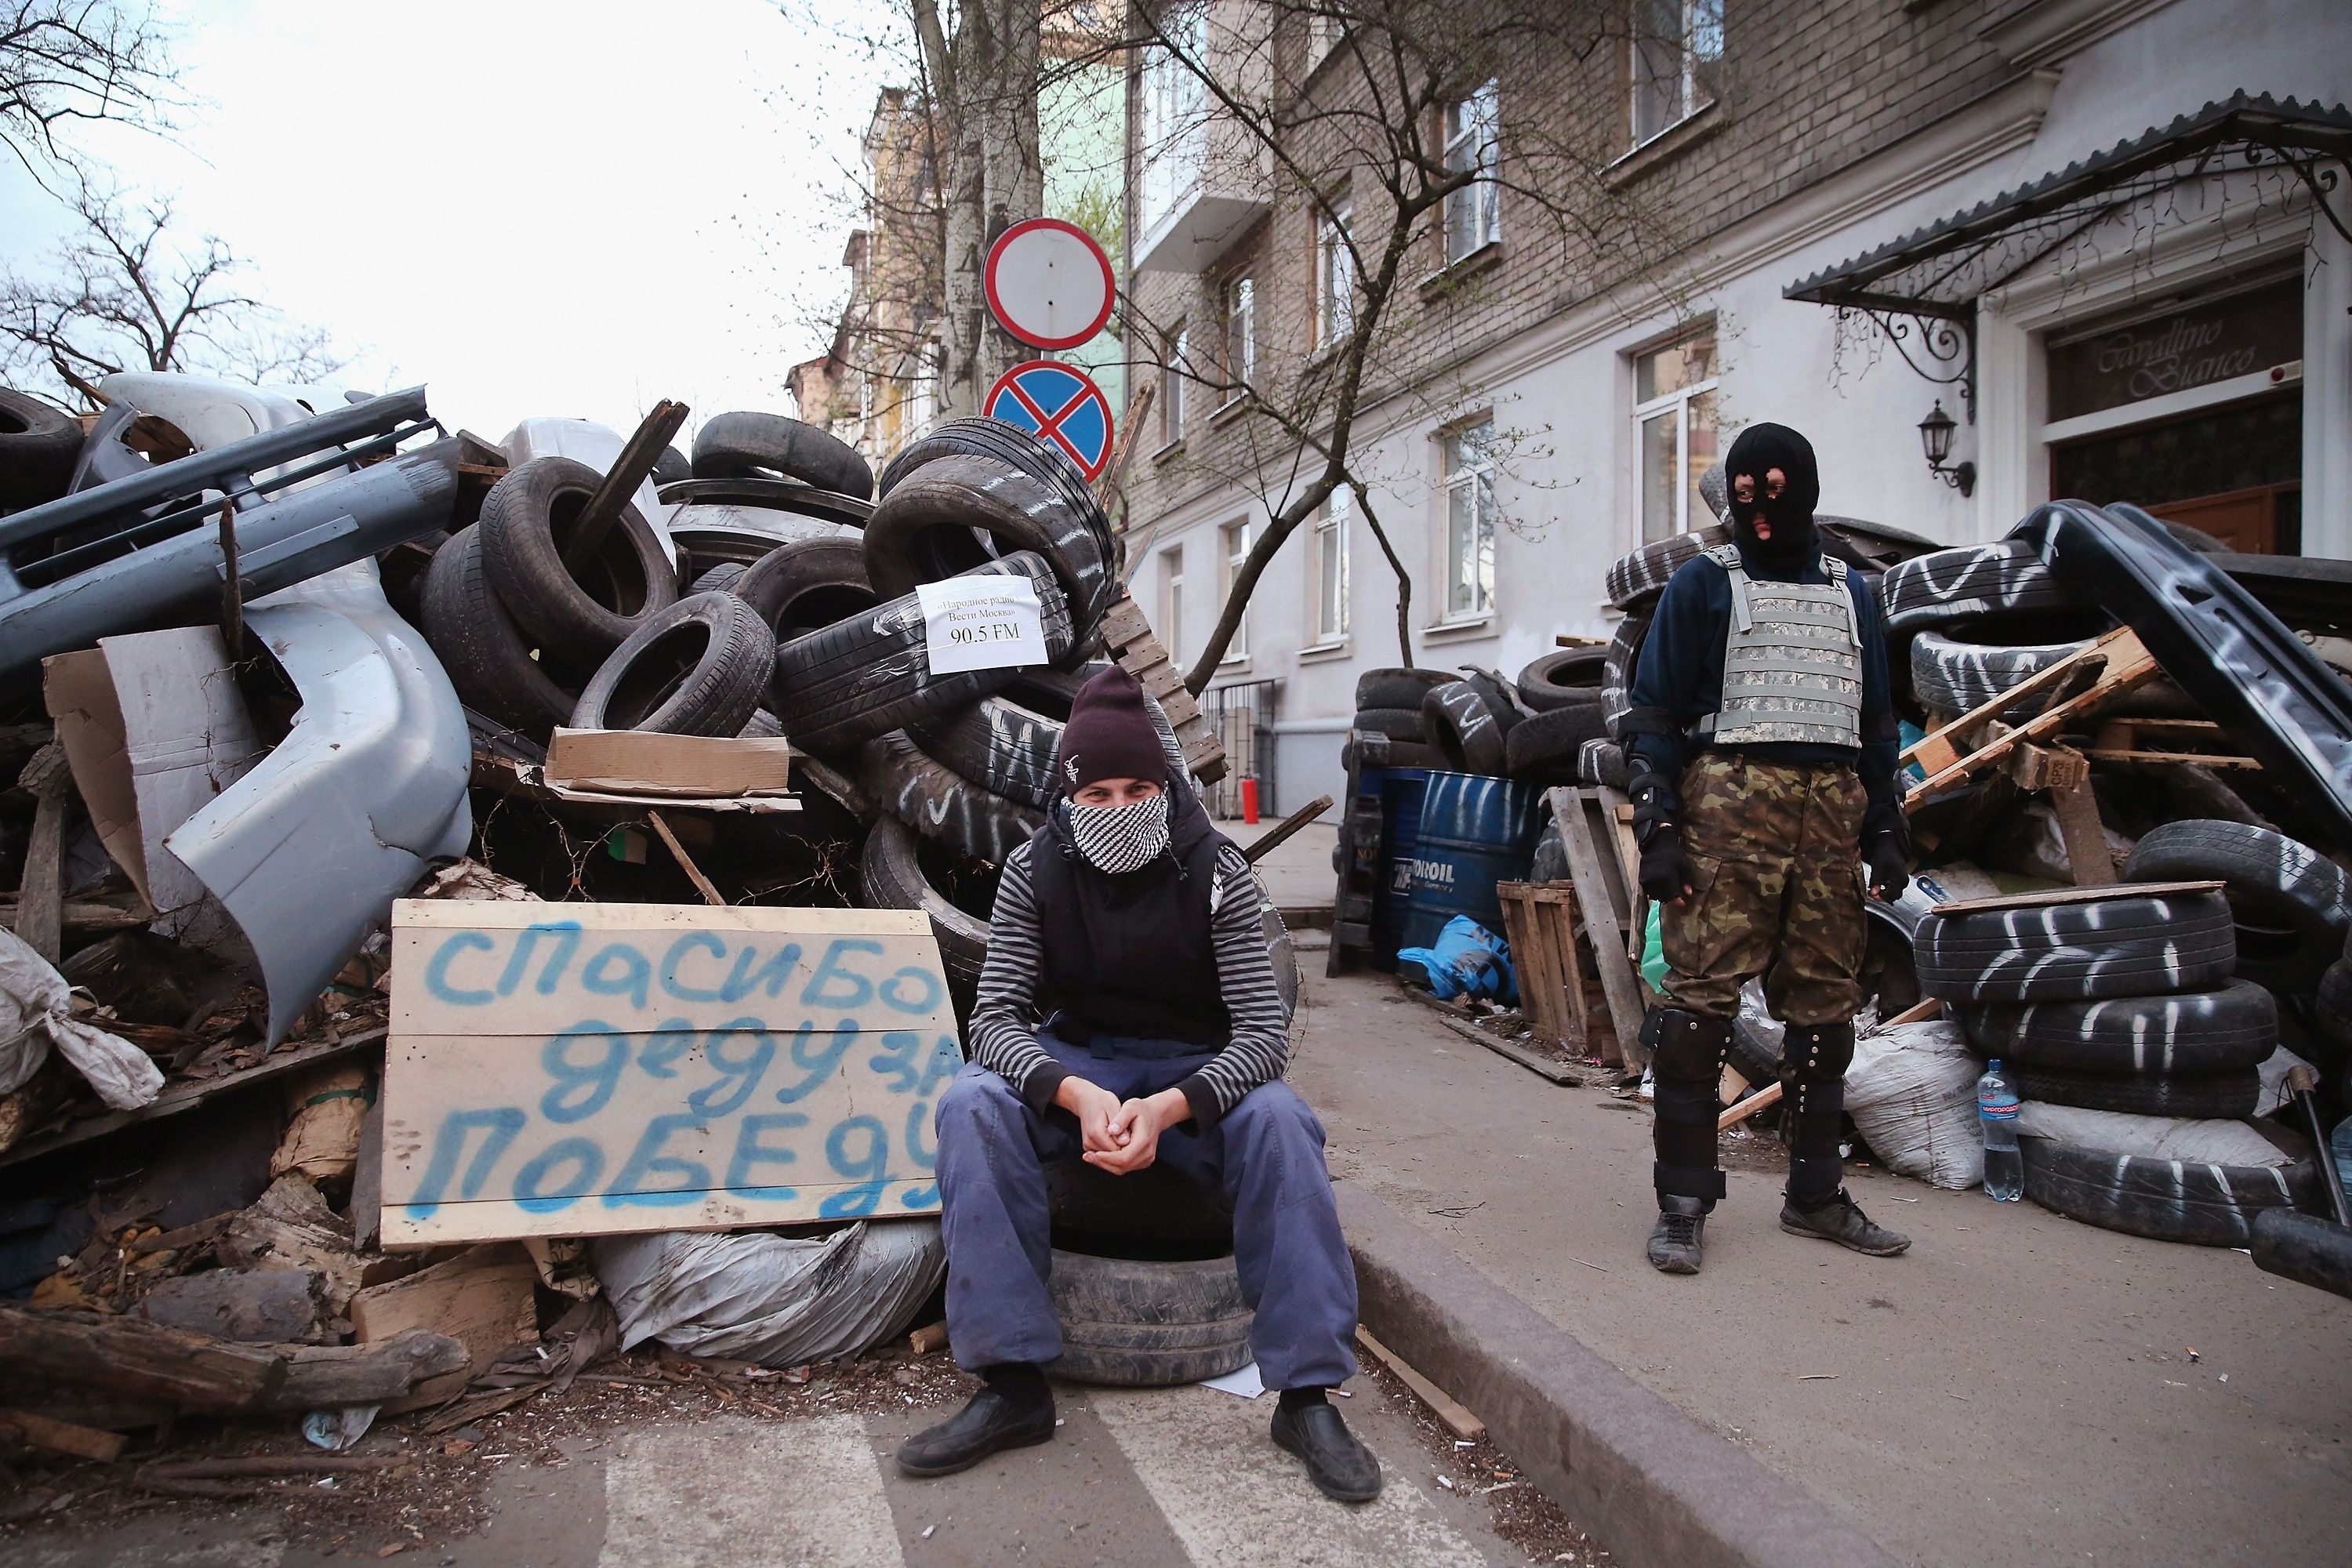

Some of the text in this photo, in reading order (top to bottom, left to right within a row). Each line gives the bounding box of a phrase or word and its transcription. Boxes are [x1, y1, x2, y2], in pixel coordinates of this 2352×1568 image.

[2099, 318, 2224, 372] Cavallino
[2129, 347, 2256, 397] Bianco
[949, 609, 1016, 622] Вести Москва»
[950, 622, 1021, 644] 90.5 FM
